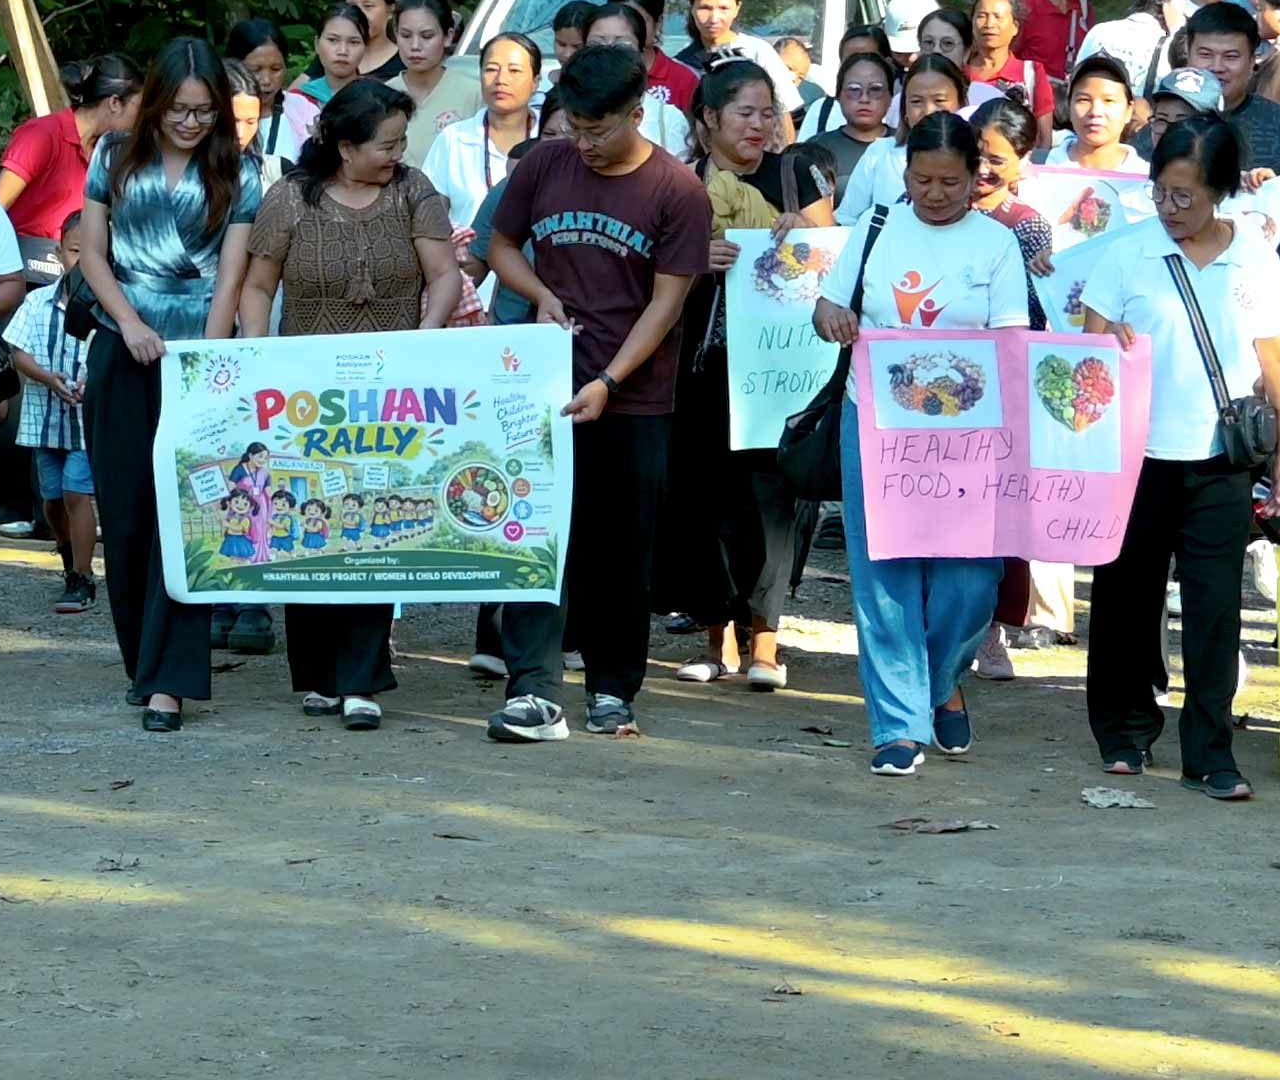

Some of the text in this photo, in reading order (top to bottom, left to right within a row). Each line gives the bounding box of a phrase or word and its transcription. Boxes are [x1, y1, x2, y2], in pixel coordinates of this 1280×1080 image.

[302, 427, 419, 457] RALLY
[880, 429, 1013, 465] HEALTHY
[882, 472, 1086, 503] FOOD, HEALTHY
[1046, 514, 1121, 540] CHILD
[332, 572, 367, 581] PROJECT
[374, 572, 407, 581] WOMEN
[416, 572, 440, 580] CHILD
[442, 571, 500, 580] DEVELOPMENT
